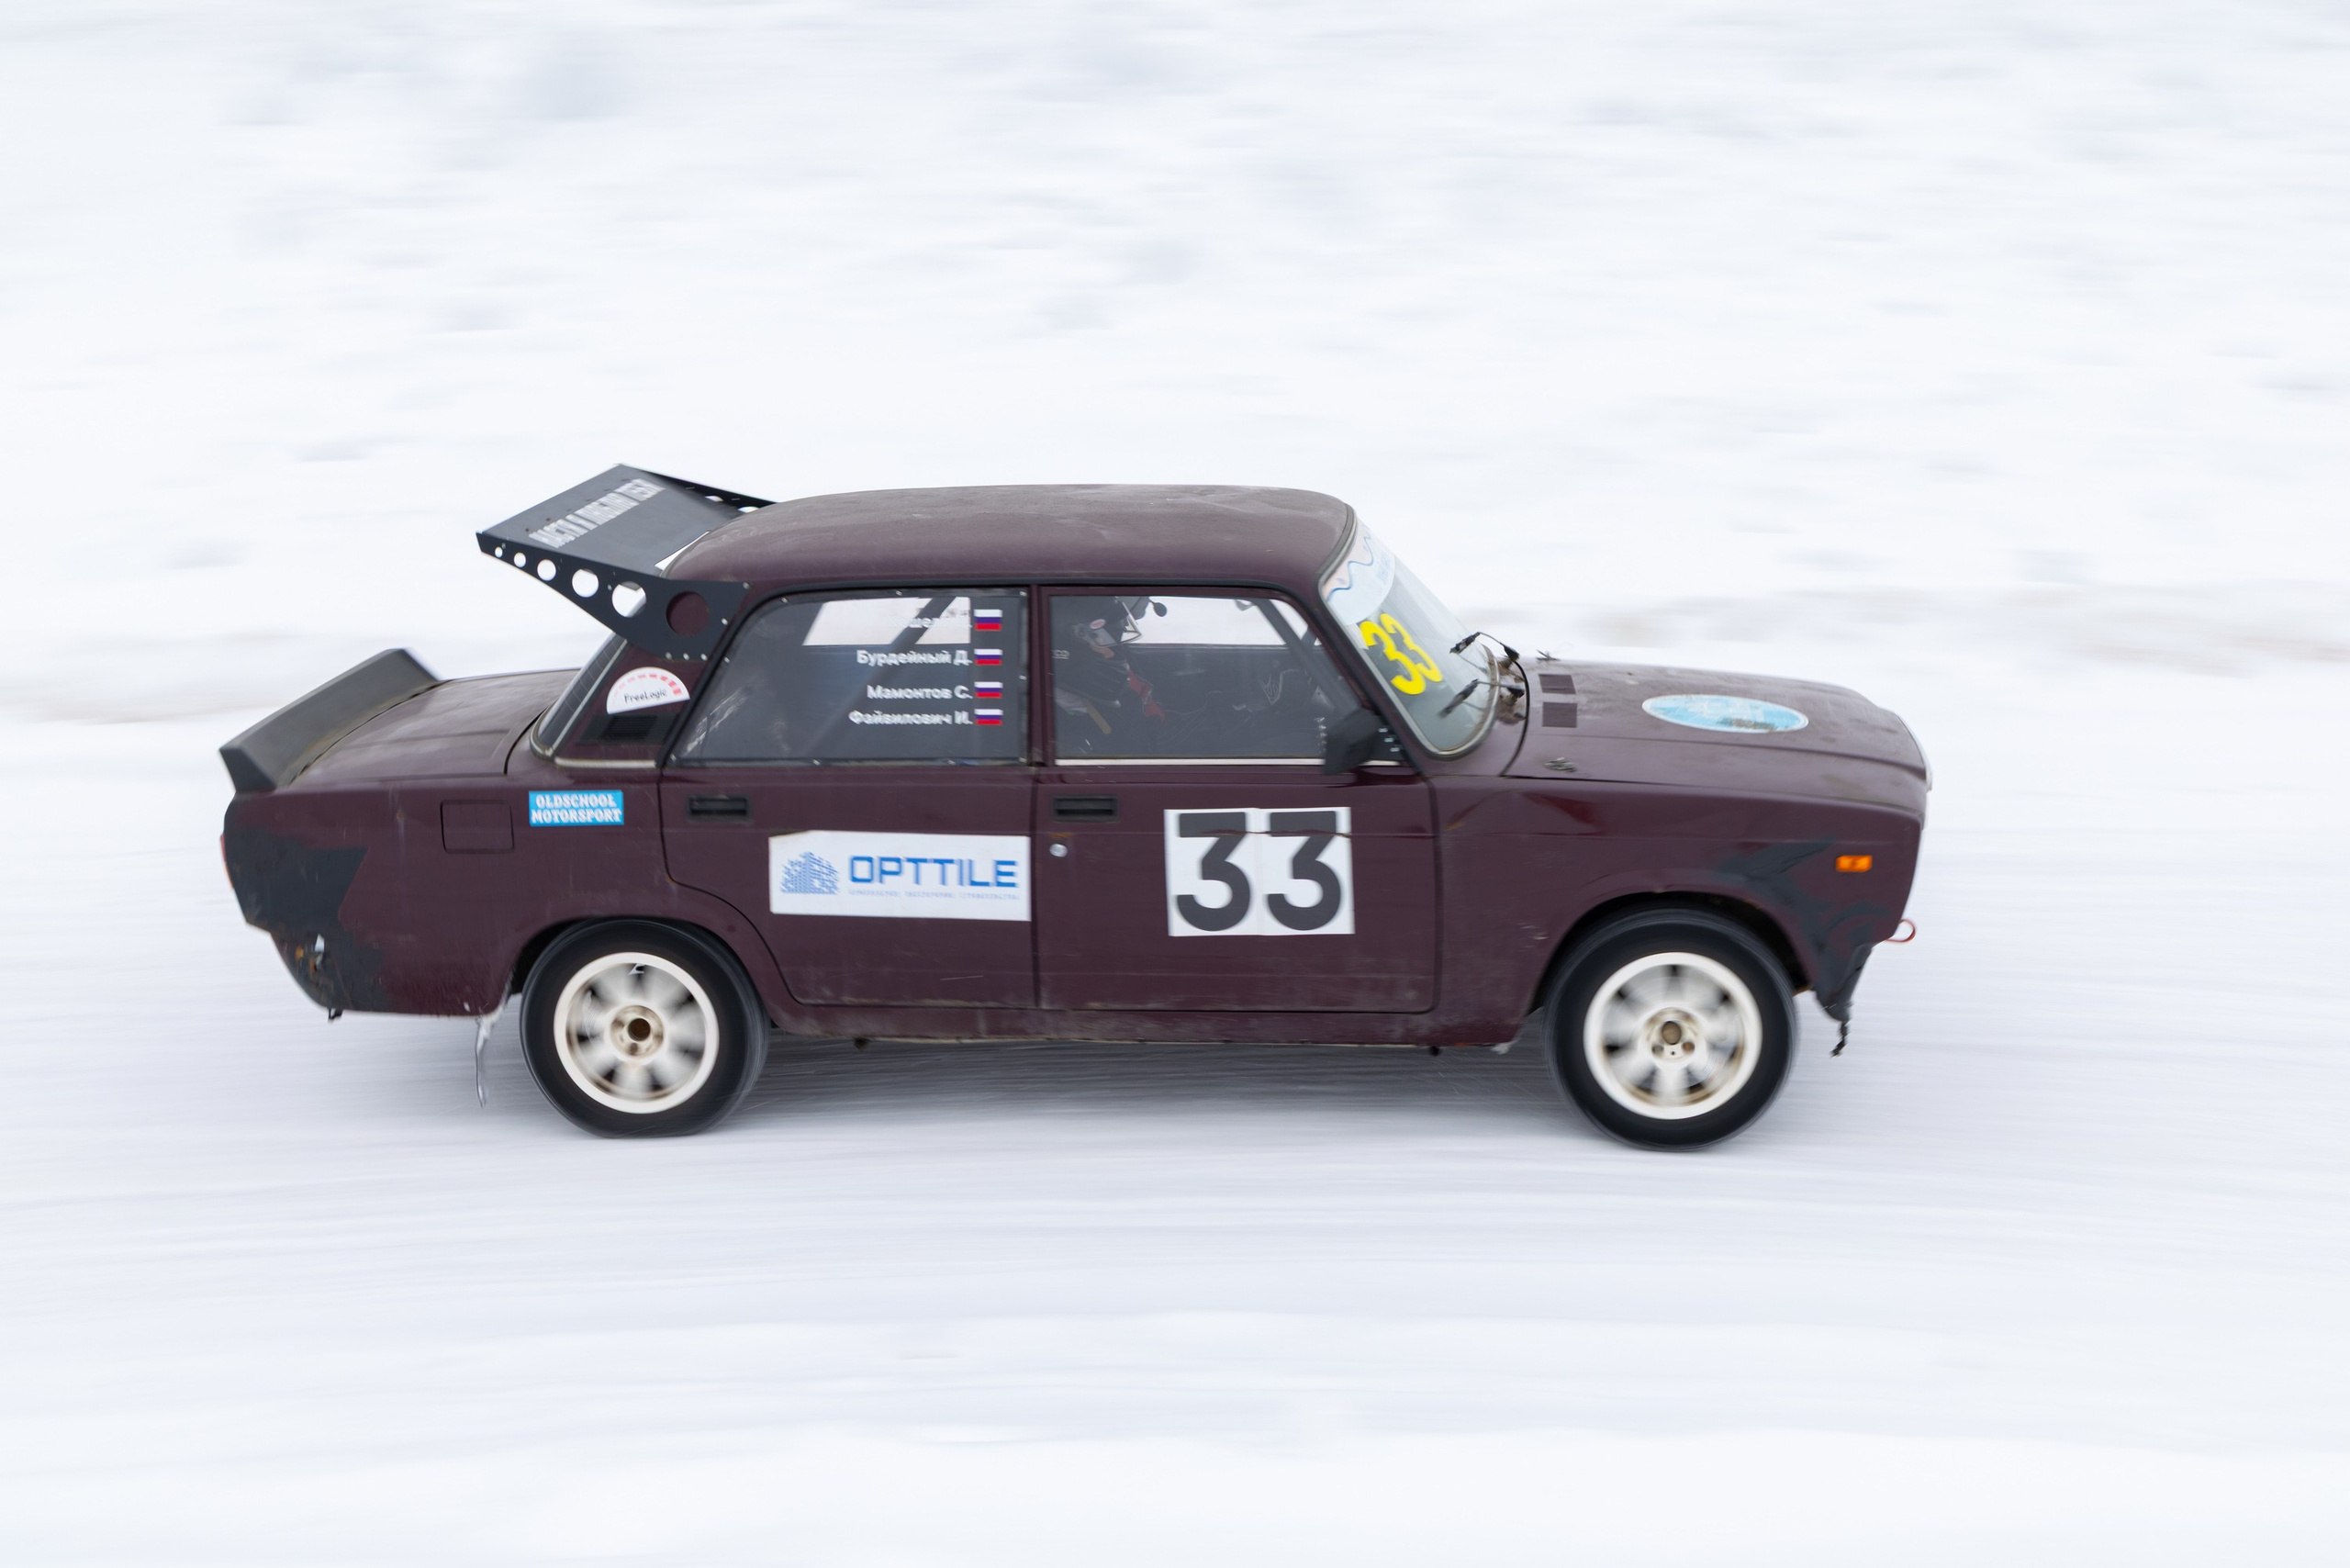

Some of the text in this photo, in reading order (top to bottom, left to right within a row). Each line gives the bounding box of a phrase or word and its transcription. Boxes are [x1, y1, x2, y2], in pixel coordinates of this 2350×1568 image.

[856, 649, 973, 666] Бурдейный Д.
[1360, 613, 1443, 694] 33
[867, 685, 973, 699] Мамонтов С.
[848, 710, 973, 724] Файвилович И.
[535, 794, 617, 809] OLDSCHOOL
[532, 808, 622, 824] MOTORSPORT
[849, 855, 1019, 888] OPTTILE
[1177, 811, 1341, 931] 33
